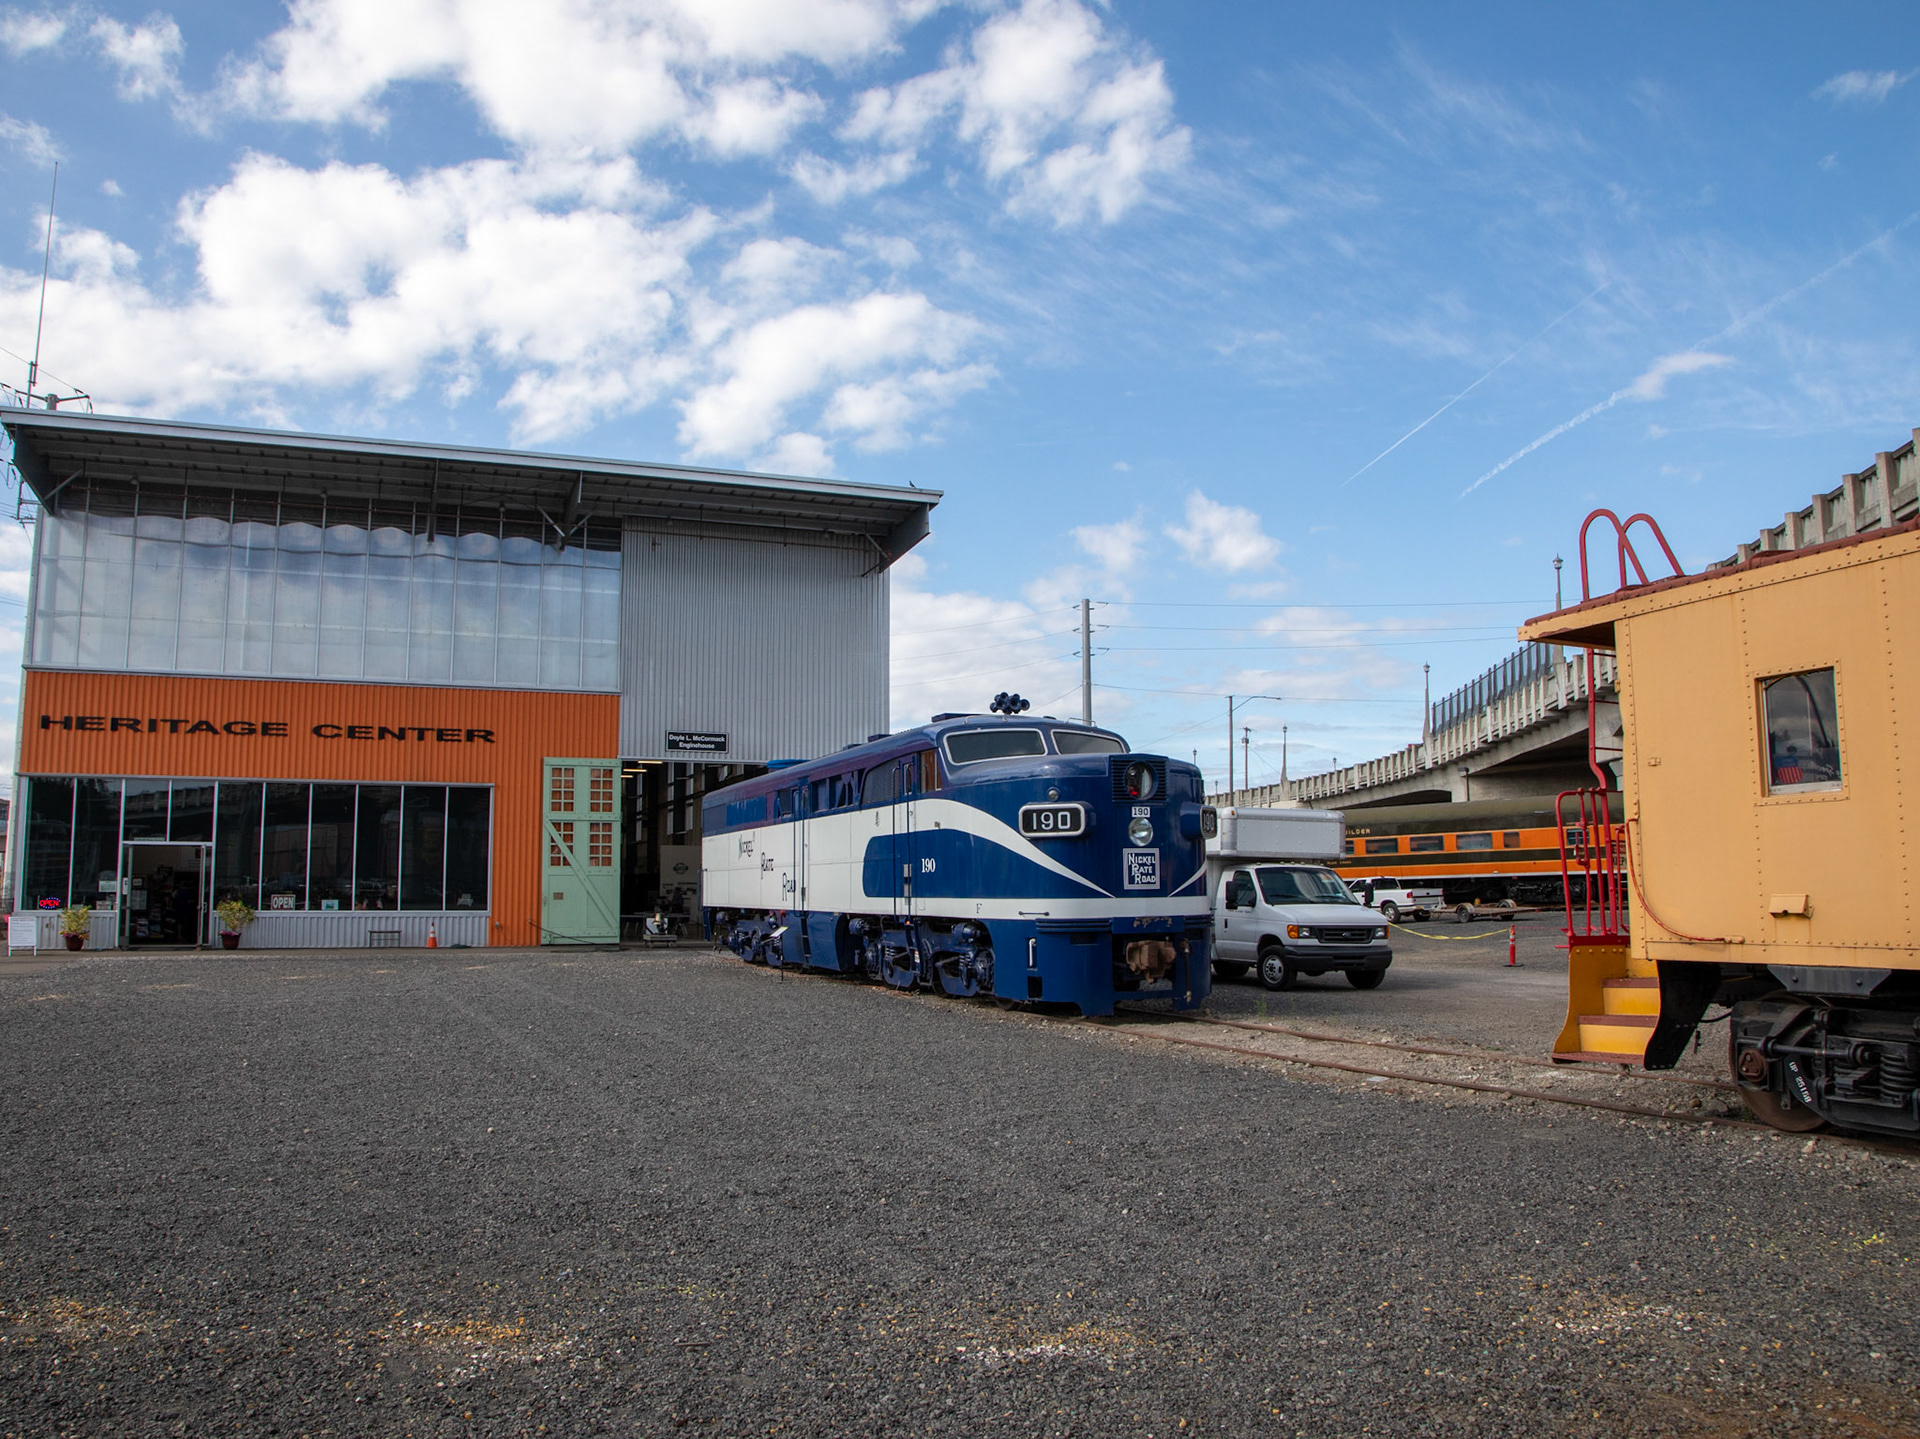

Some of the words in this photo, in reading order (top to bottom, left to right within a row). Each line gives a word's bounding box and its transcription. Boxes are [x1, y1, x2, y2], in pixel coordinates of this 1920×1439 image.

[41, 715, 288, 737] HERITAGE
[312, 724, 496, 743] CENTER
[1133, 807, 1149, 816] 190
[1032, 811, 1071, 830] 190
[1203, 813, 1215, 831] 190
[1345, 828, 1371, 836] ILDER
[921, 858, 936, 873] 190
[1128, 853, 1156, 866] NICKEL
[1134, 873, 1156, 884] ROAD
[272, 896, 294, 909] OPEN
